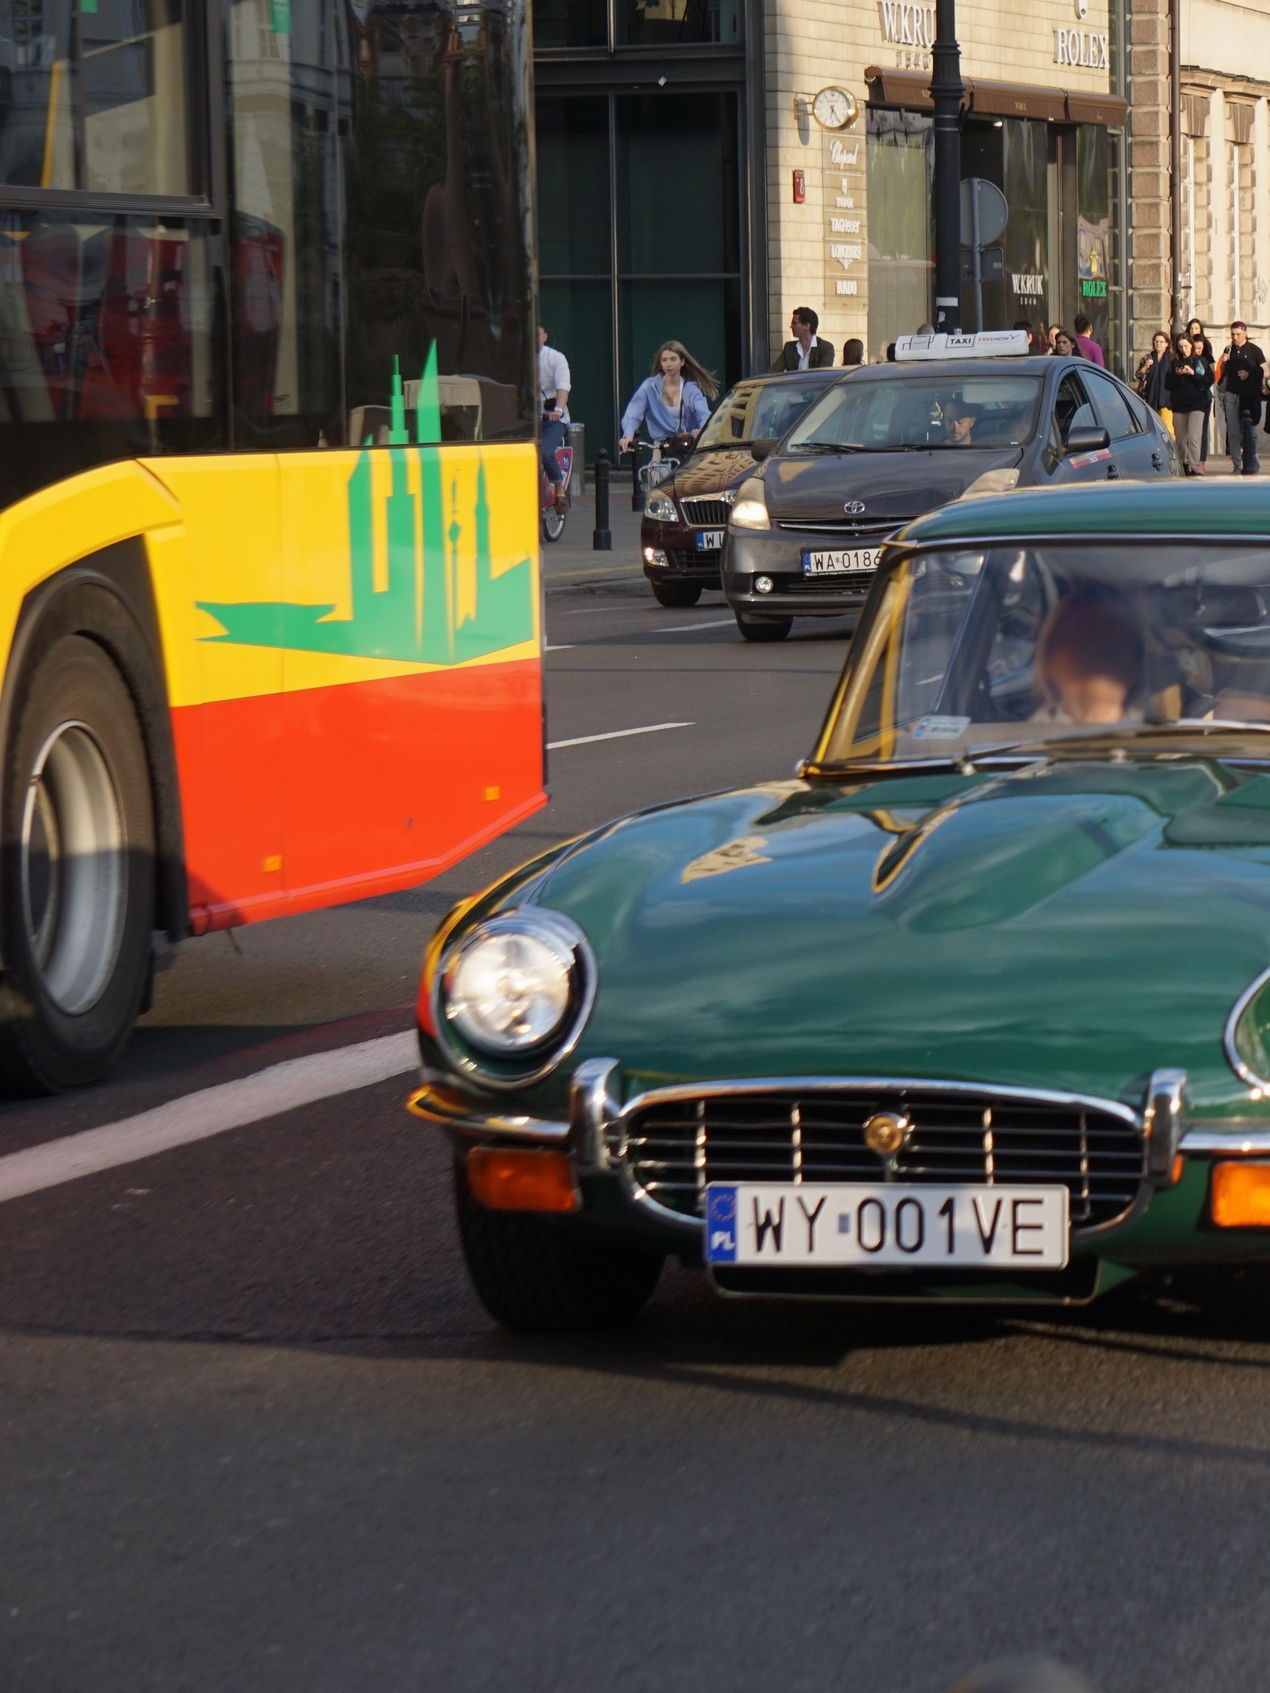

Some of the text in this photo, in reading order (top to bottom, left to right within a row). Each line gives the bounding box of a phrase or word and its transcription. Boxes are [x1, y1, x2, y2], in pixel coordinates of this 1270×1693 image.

[880, 1, 937, 48] W.KRU
[1054, 28, 1110, 69] ROLEX
[836, 280, 857, 295] RADO
[1012, 274, 1043, 295] W.KRUK
[1082, 281, 1107, 297] ROLEX
[1020, 297, 1037, 305] 1840
[814, 553, 836, 570] WA
[711, 1195, 1044, 1256] PL WY 001VE
